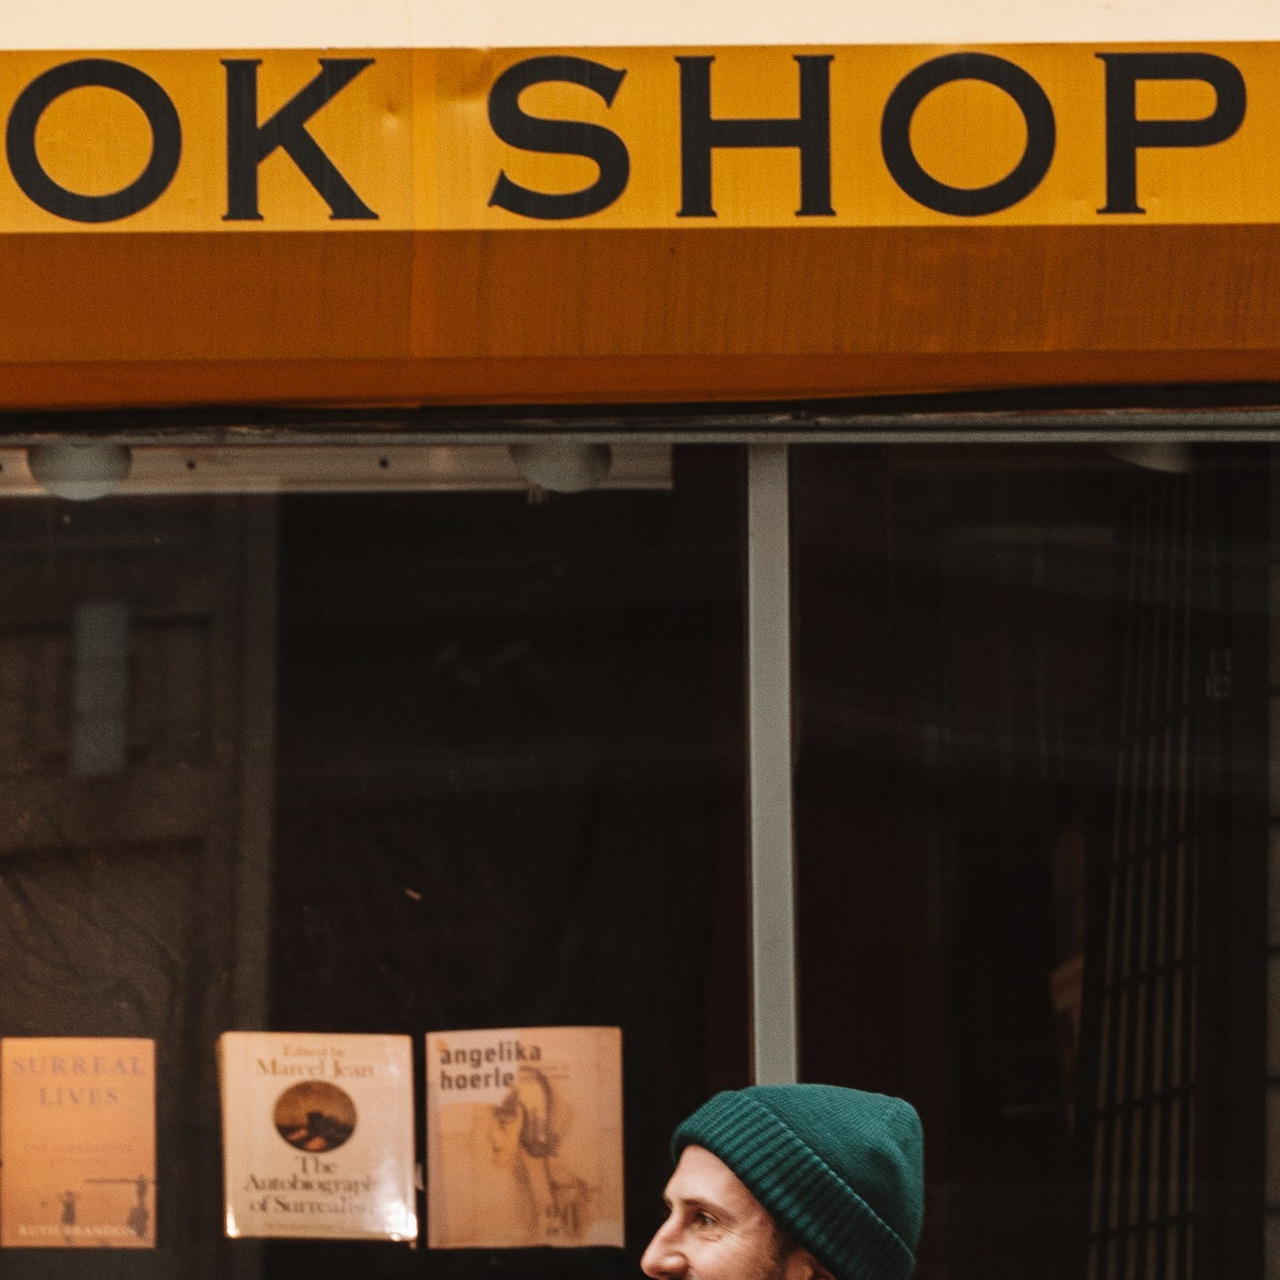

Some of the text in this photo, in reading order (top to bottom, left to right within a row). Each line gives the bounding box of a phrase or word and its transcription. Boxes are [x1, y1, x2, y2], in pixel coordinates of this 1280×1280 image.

[486, 50, 1249, 221] SHOP
[439, 1037, 542, 1068] angelika
[13, 1056, 146, 1076] SURREAL
[439, 1068, 515, 1091] hoerle
[39, 1087, 119, 1107] LIVES
[294, 1156, 338, 1174] The
[244, 1173, 388, 1197] Autobiograph
